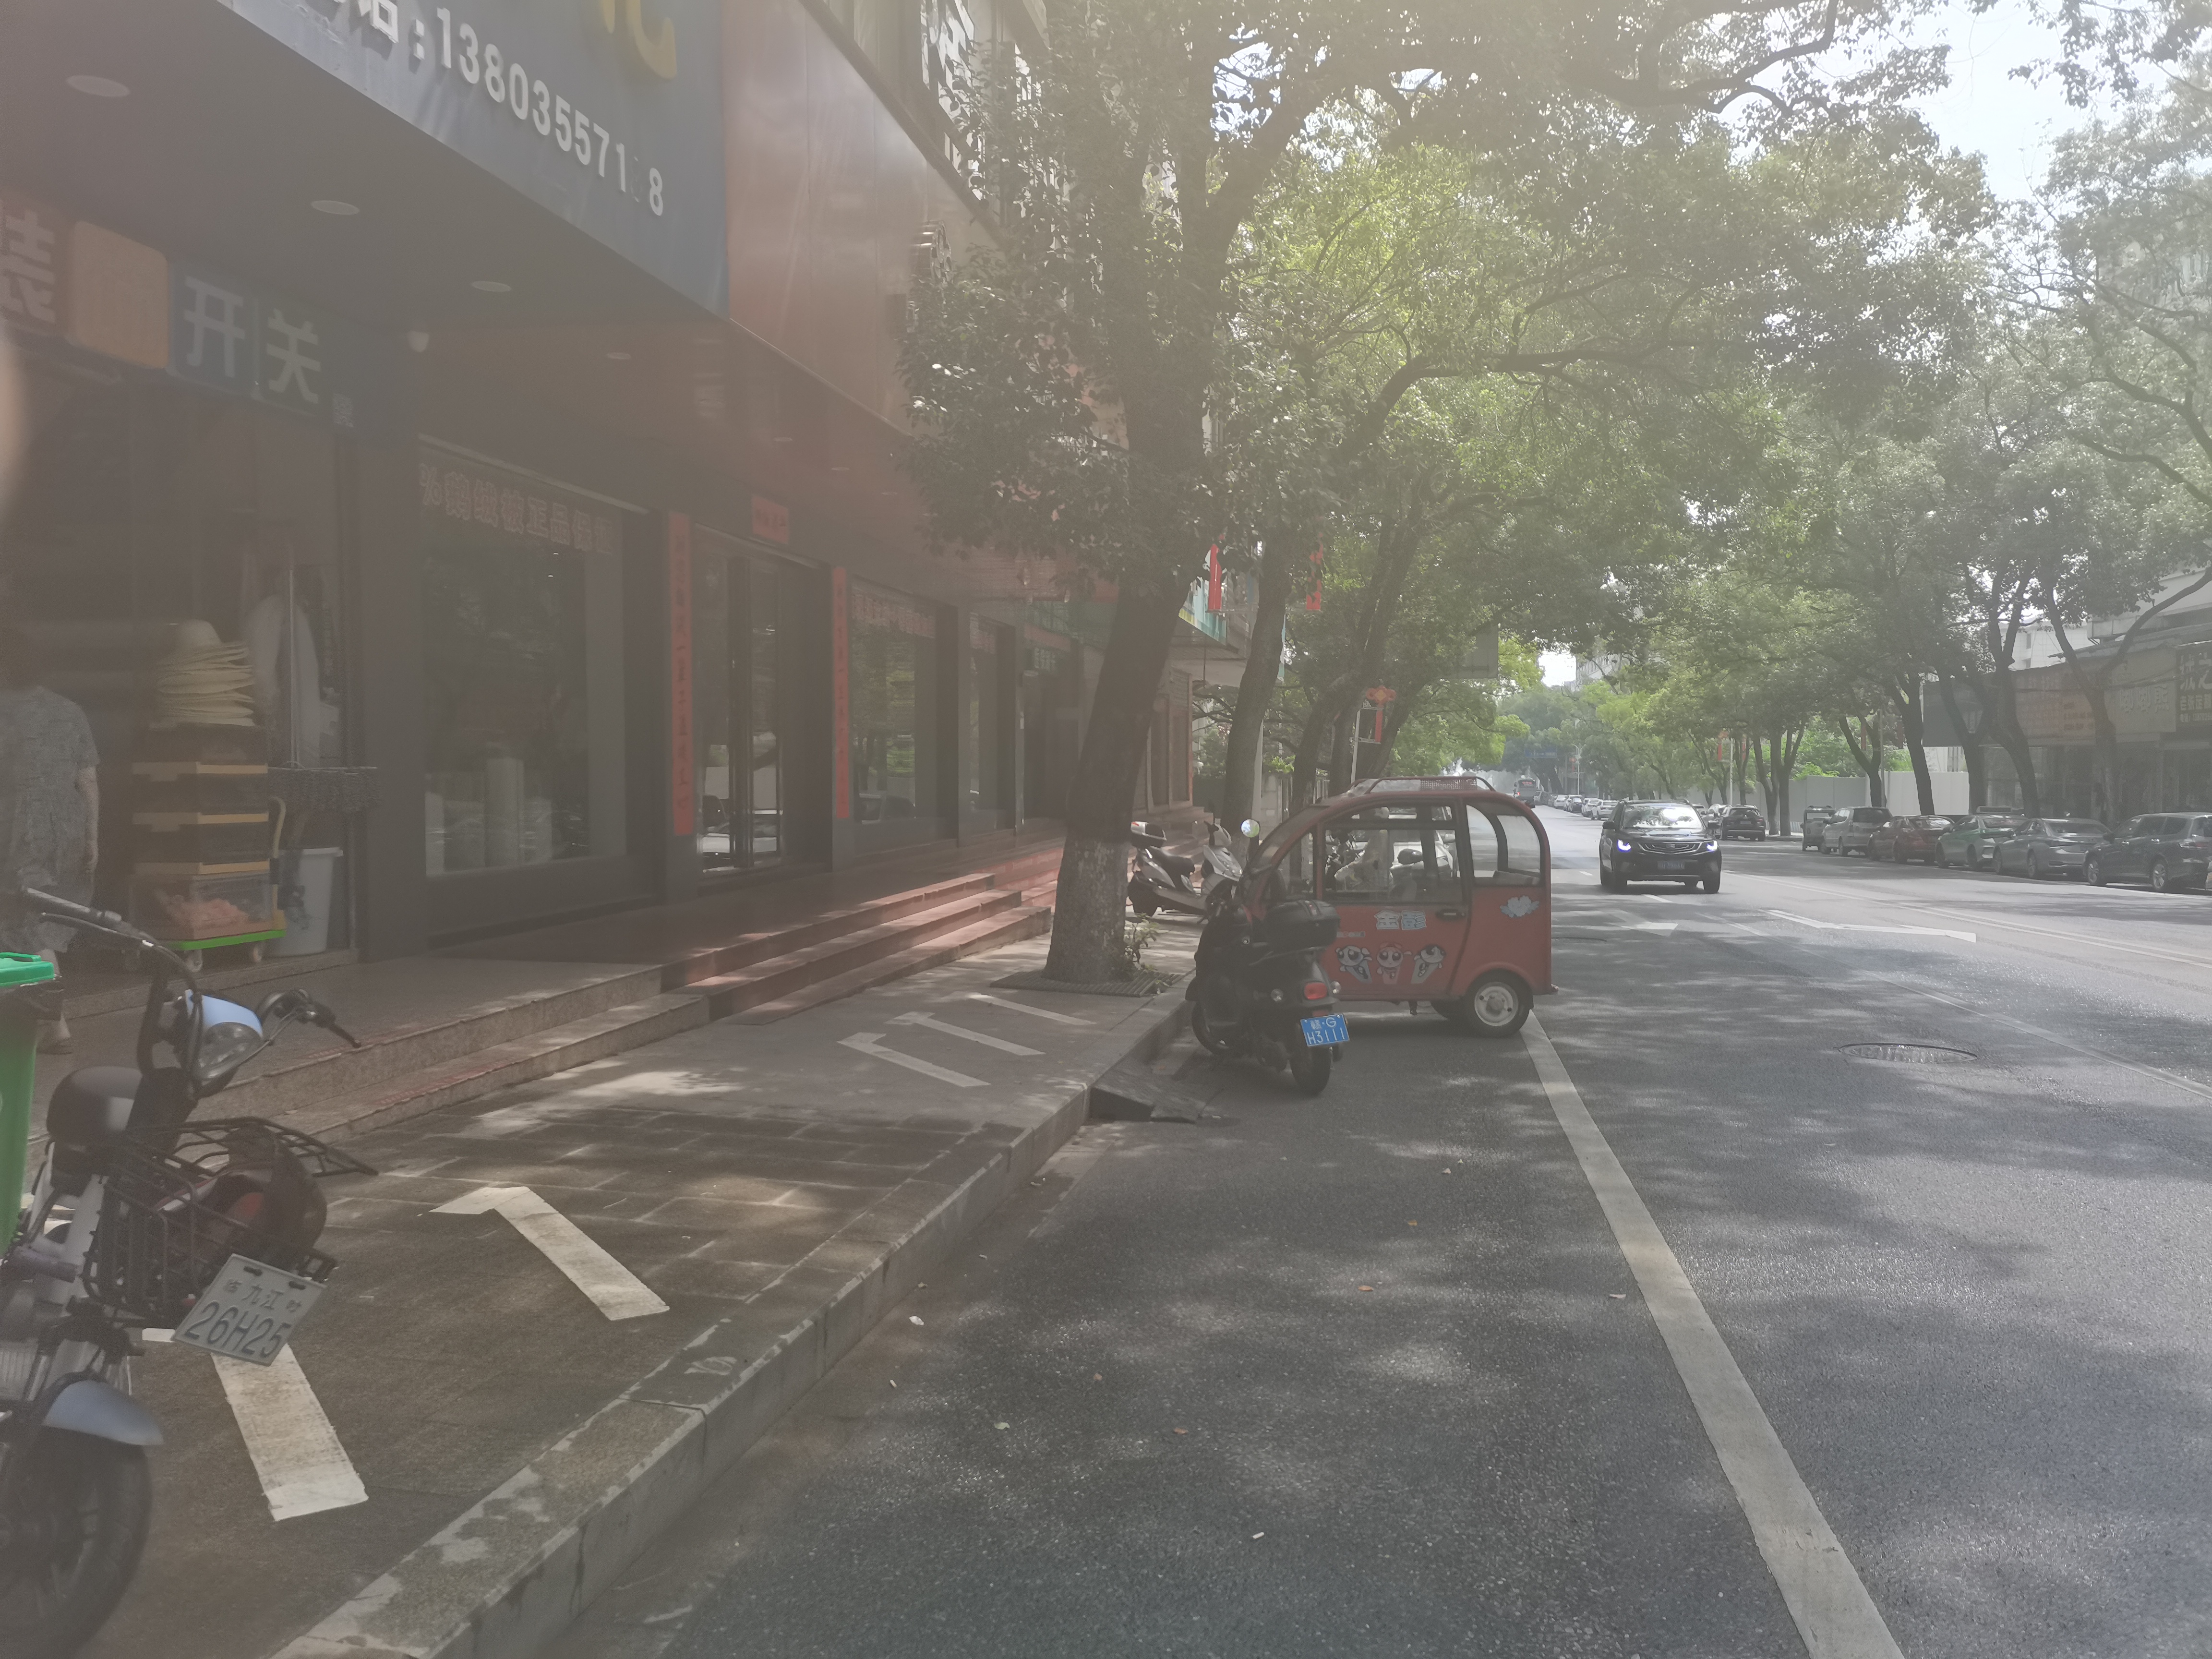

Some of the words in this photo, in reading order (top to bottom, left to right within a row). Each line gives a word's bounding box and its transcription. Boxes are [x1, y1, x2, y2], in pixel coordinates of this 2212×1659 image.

[183, 276, 321, 404] 开关
[1374, 910, 1427, 930] 金彭
[1307, 1027, 1345, 1045] H3111
[183, 1301, 292, 1358] 26H25
